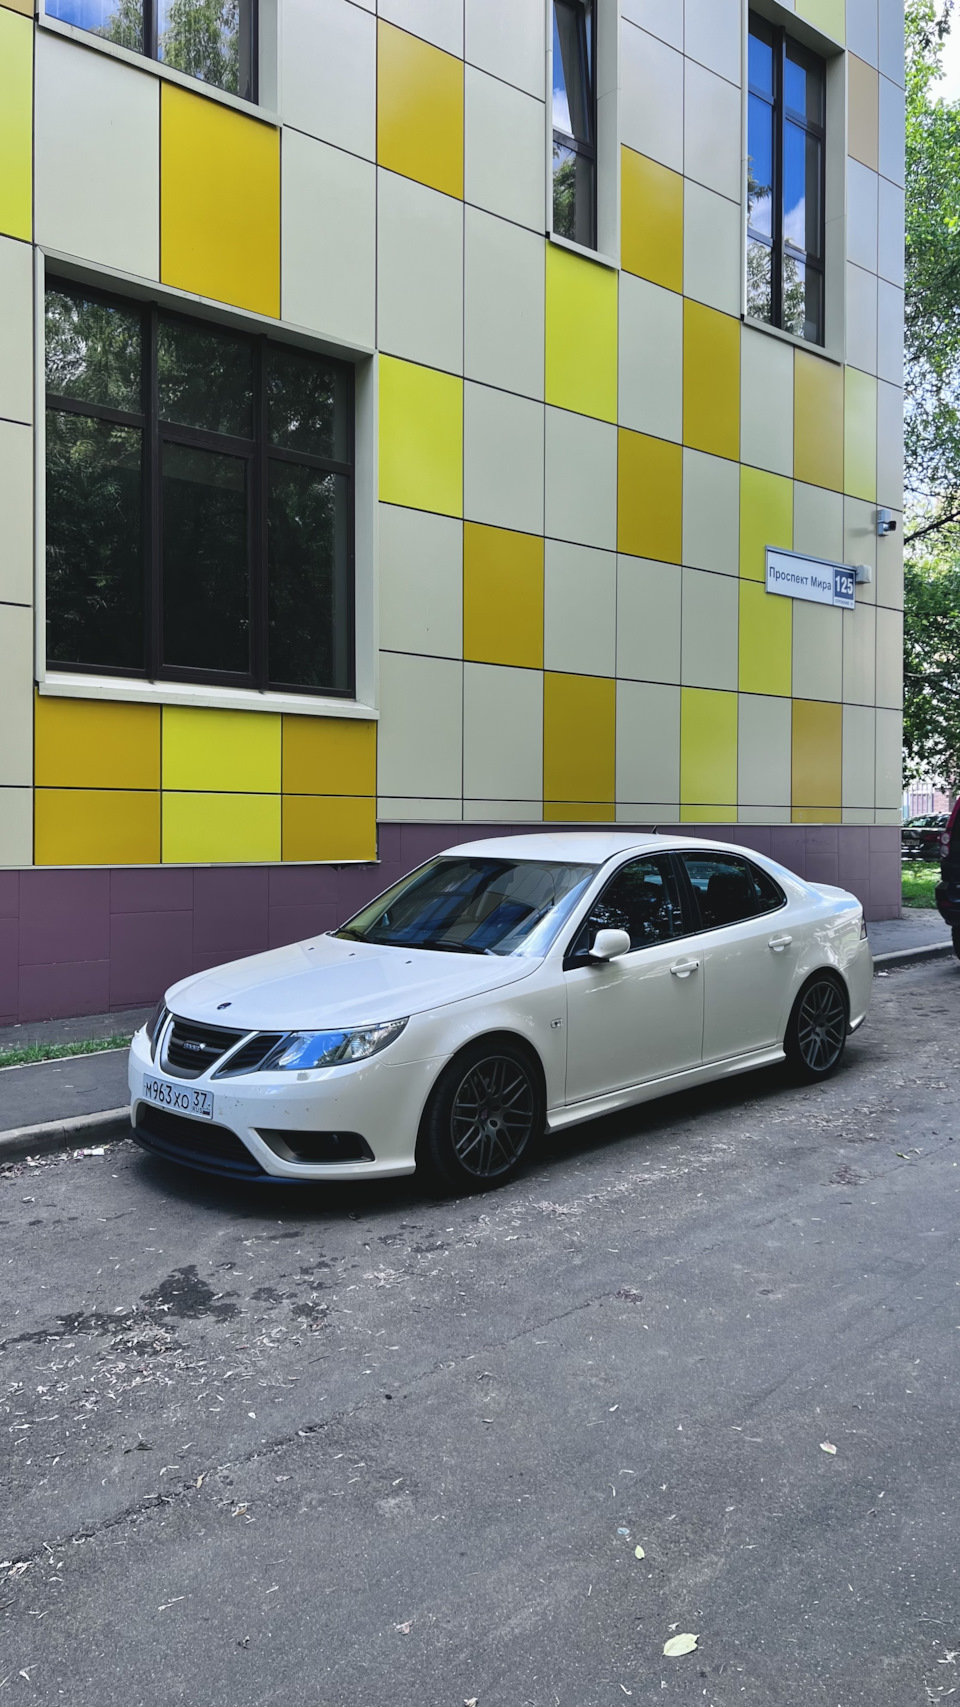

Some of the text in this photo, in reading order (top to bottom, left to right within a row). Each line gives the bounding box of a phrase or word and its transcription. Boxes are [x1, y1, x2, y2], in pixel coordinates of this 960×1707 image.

[769, 566, 832, 592] Проспект Мира
[835, 575, 854, 595] 125
[193, 1090, 207, 1108] 37
[192, 1105, 203, 1114] RUS
